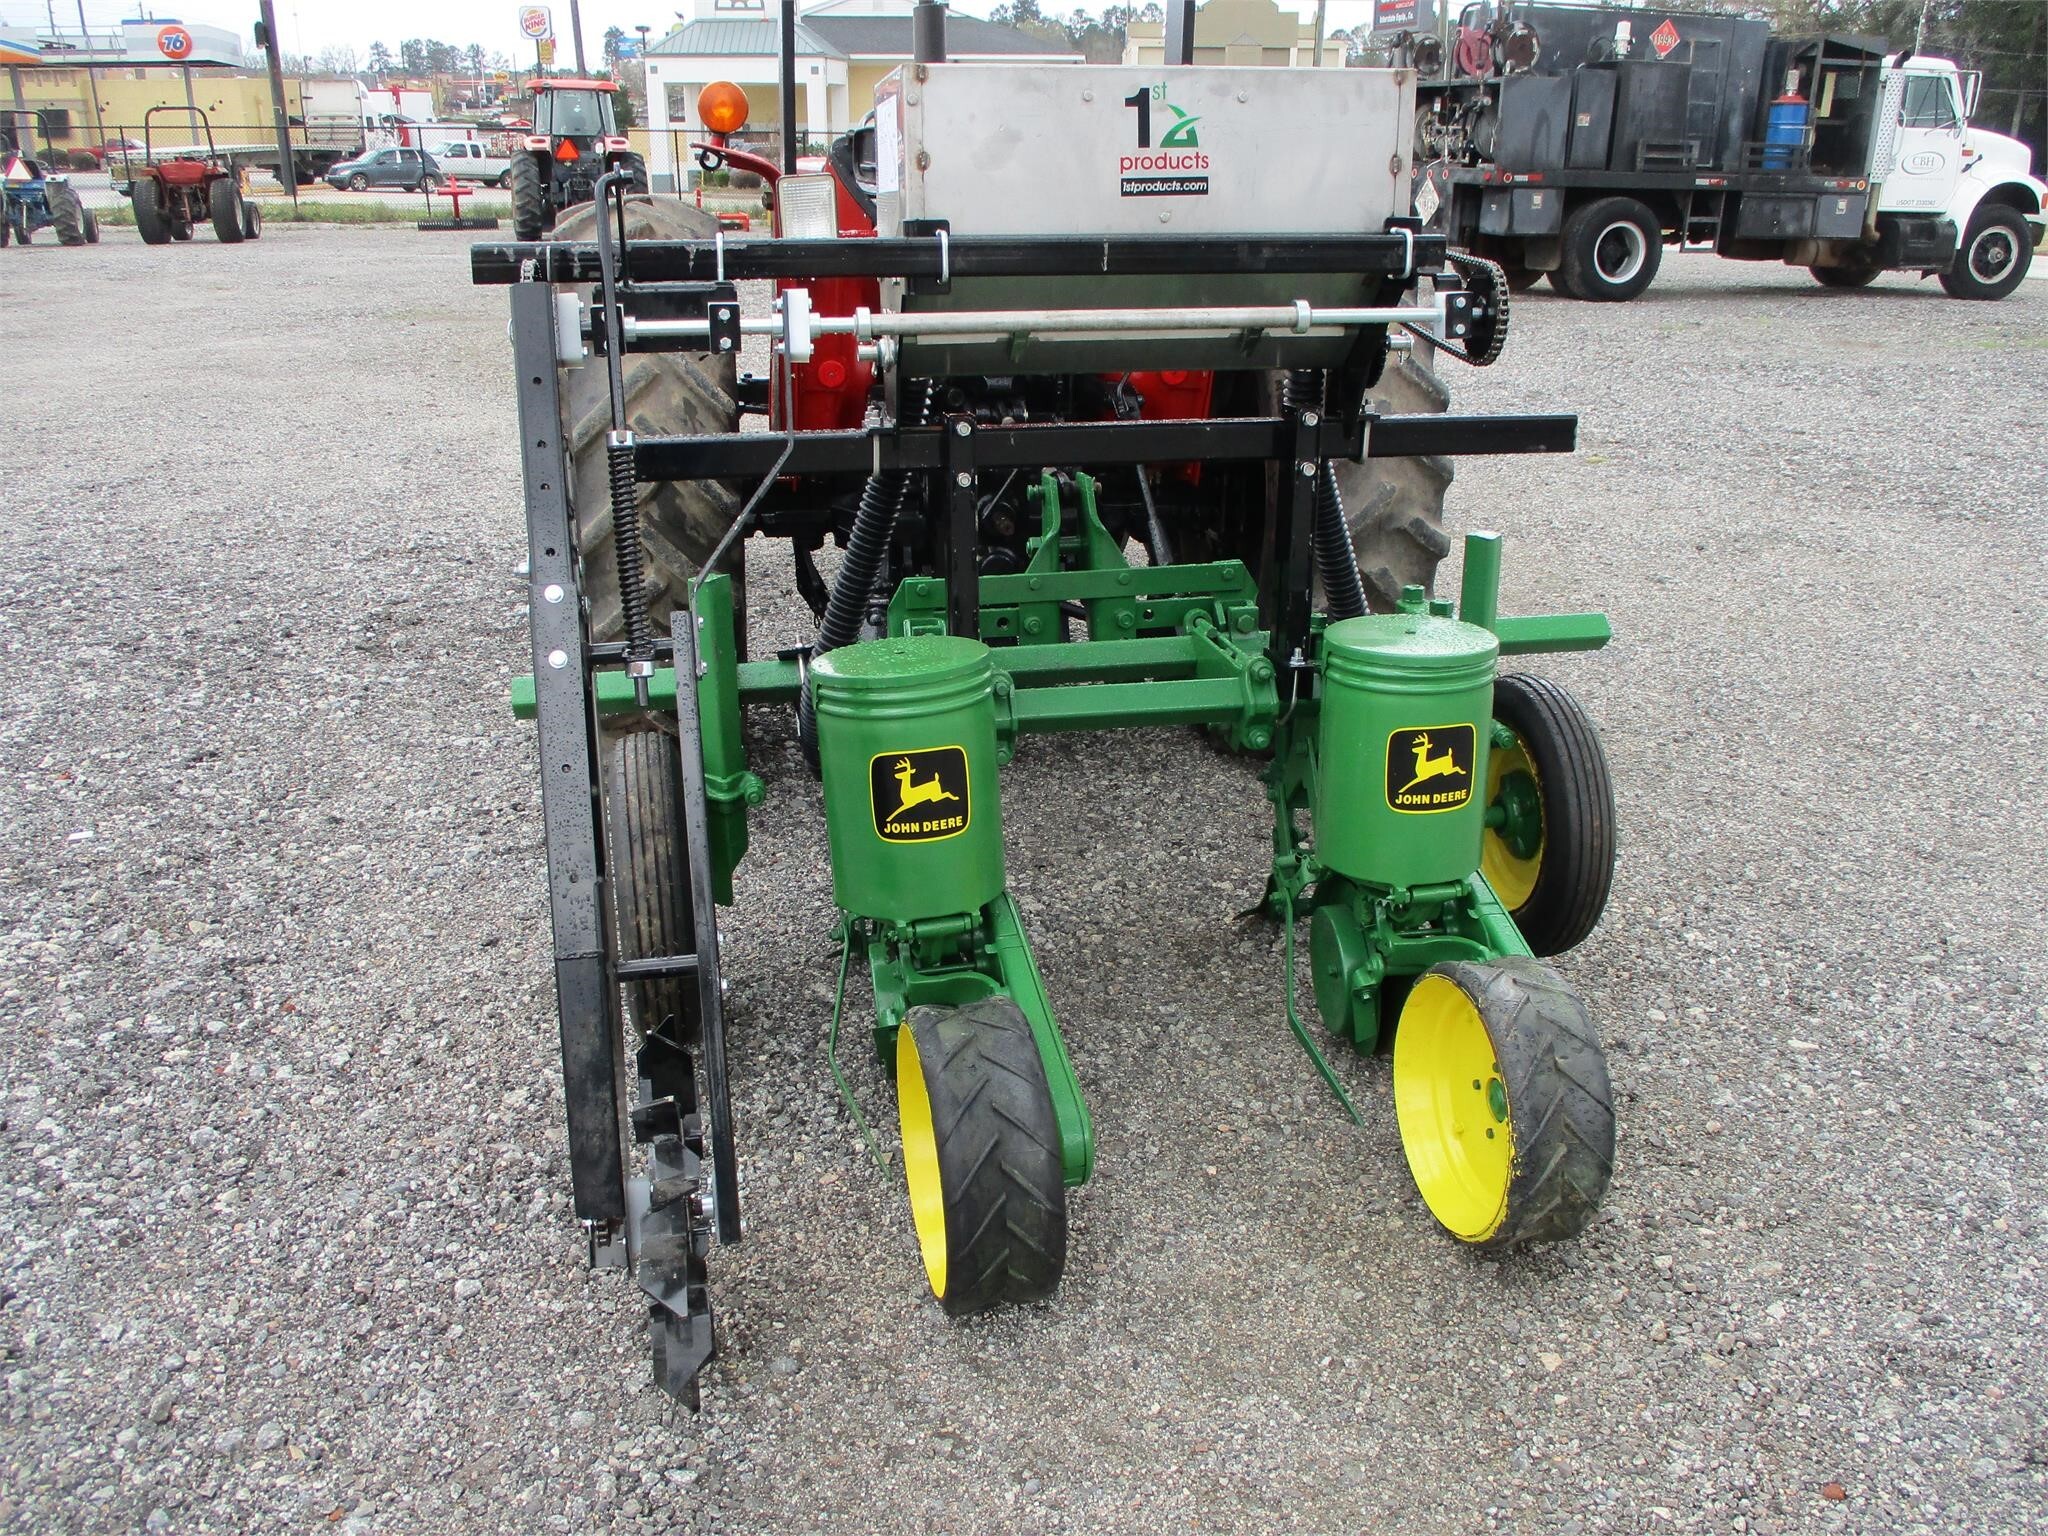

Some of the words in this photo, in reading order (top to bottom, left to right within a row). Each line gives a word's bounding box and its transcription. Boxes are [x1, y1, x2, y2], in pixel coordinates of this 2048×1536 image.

[525, 18, 546, 31] KING
[162, 33, 187, 52] 76
[1120, 151, 1210, 175] products
[1912, 156, 1936, 167] CBH
[1122, 180, 1208, 194] 1stproducts.com
[1395, 794, 1431, 805] JOHN
[1433, 789, 1468, 804] DEERE
[883, 822, 920, 834] JOHN
[922, 815, 964, 832] DEERE
